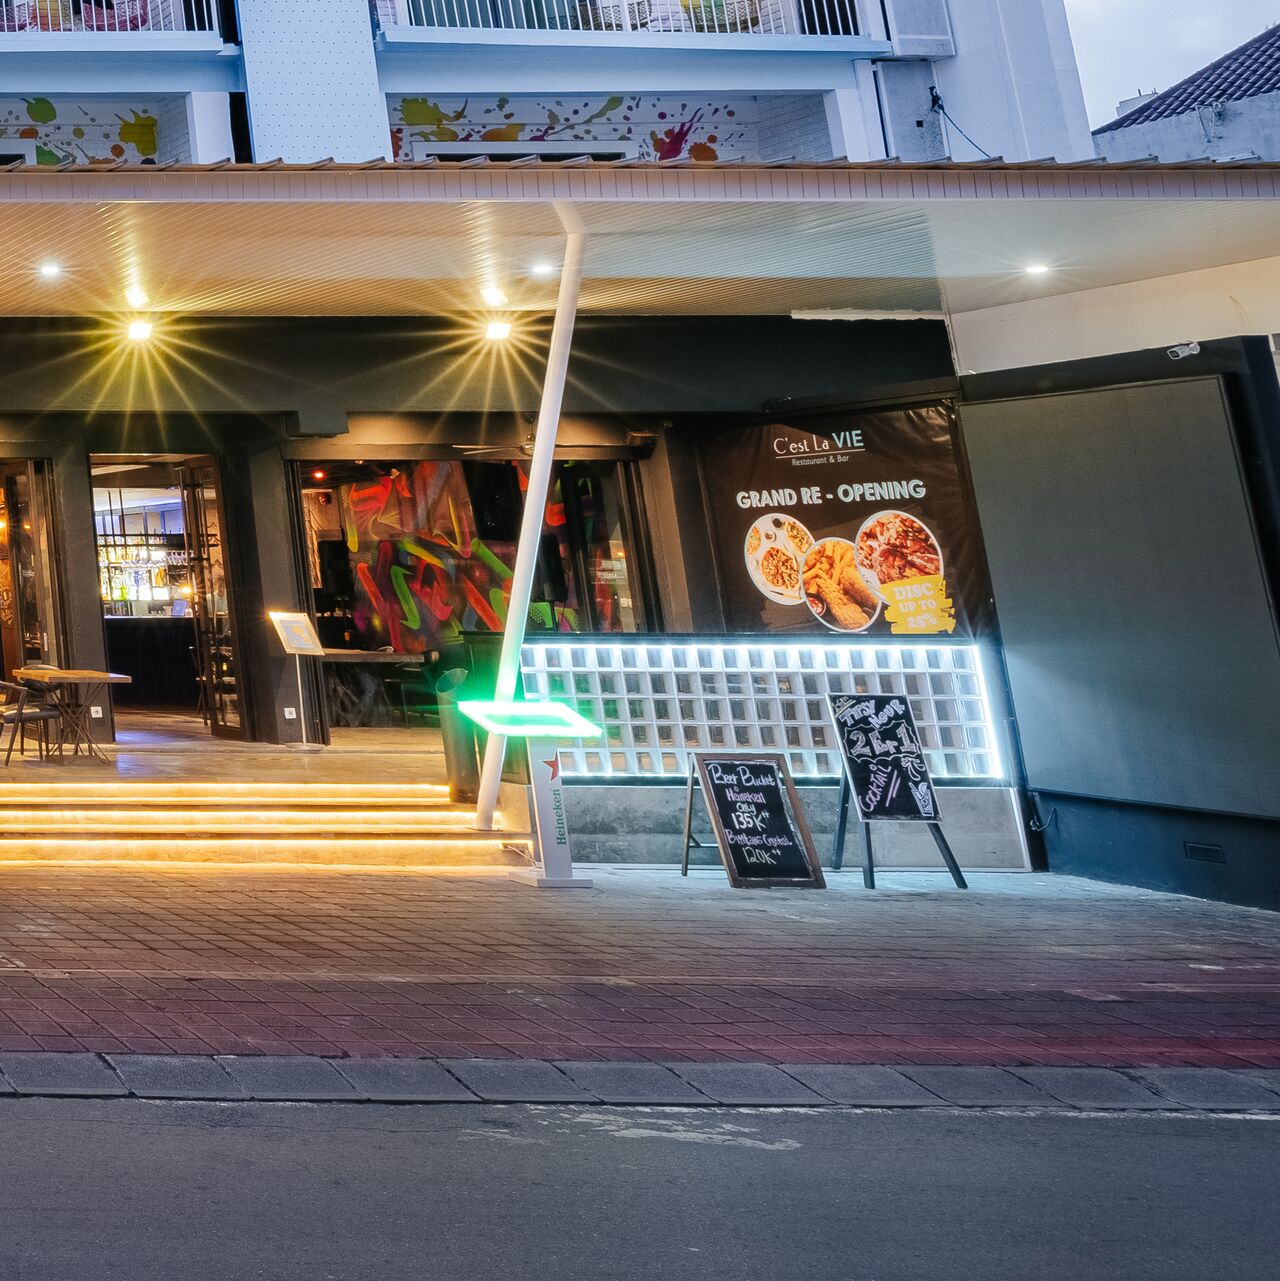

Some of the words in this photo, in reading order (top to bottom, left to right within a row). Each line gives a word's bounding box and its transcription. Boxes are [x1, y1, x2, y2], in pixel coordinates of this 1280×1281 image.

[774, 437, 810, 455] C'est
[812, 434, 830, 451] La
[832, 430, 864, 449] VIE
[791, 455, 828, 467] Restaurant
[829, 455, 835, 463] &
[837, 454, 850, 463] Bar
[736, 489, 797, 509] GRAND
[800, 486, 823, 505] RE
[837, 479, 927, 503] OPENING
[893, 583, 934, 601] DISC
[899, 601, 917, 613] UP
[919, 599, 937, 610] TO
[849, 730, 873, 756] 2
[895, 723, 918, 753] 1
[708, 763, 738, 785] Beer
[552, 788, 567, 846] Heineken
